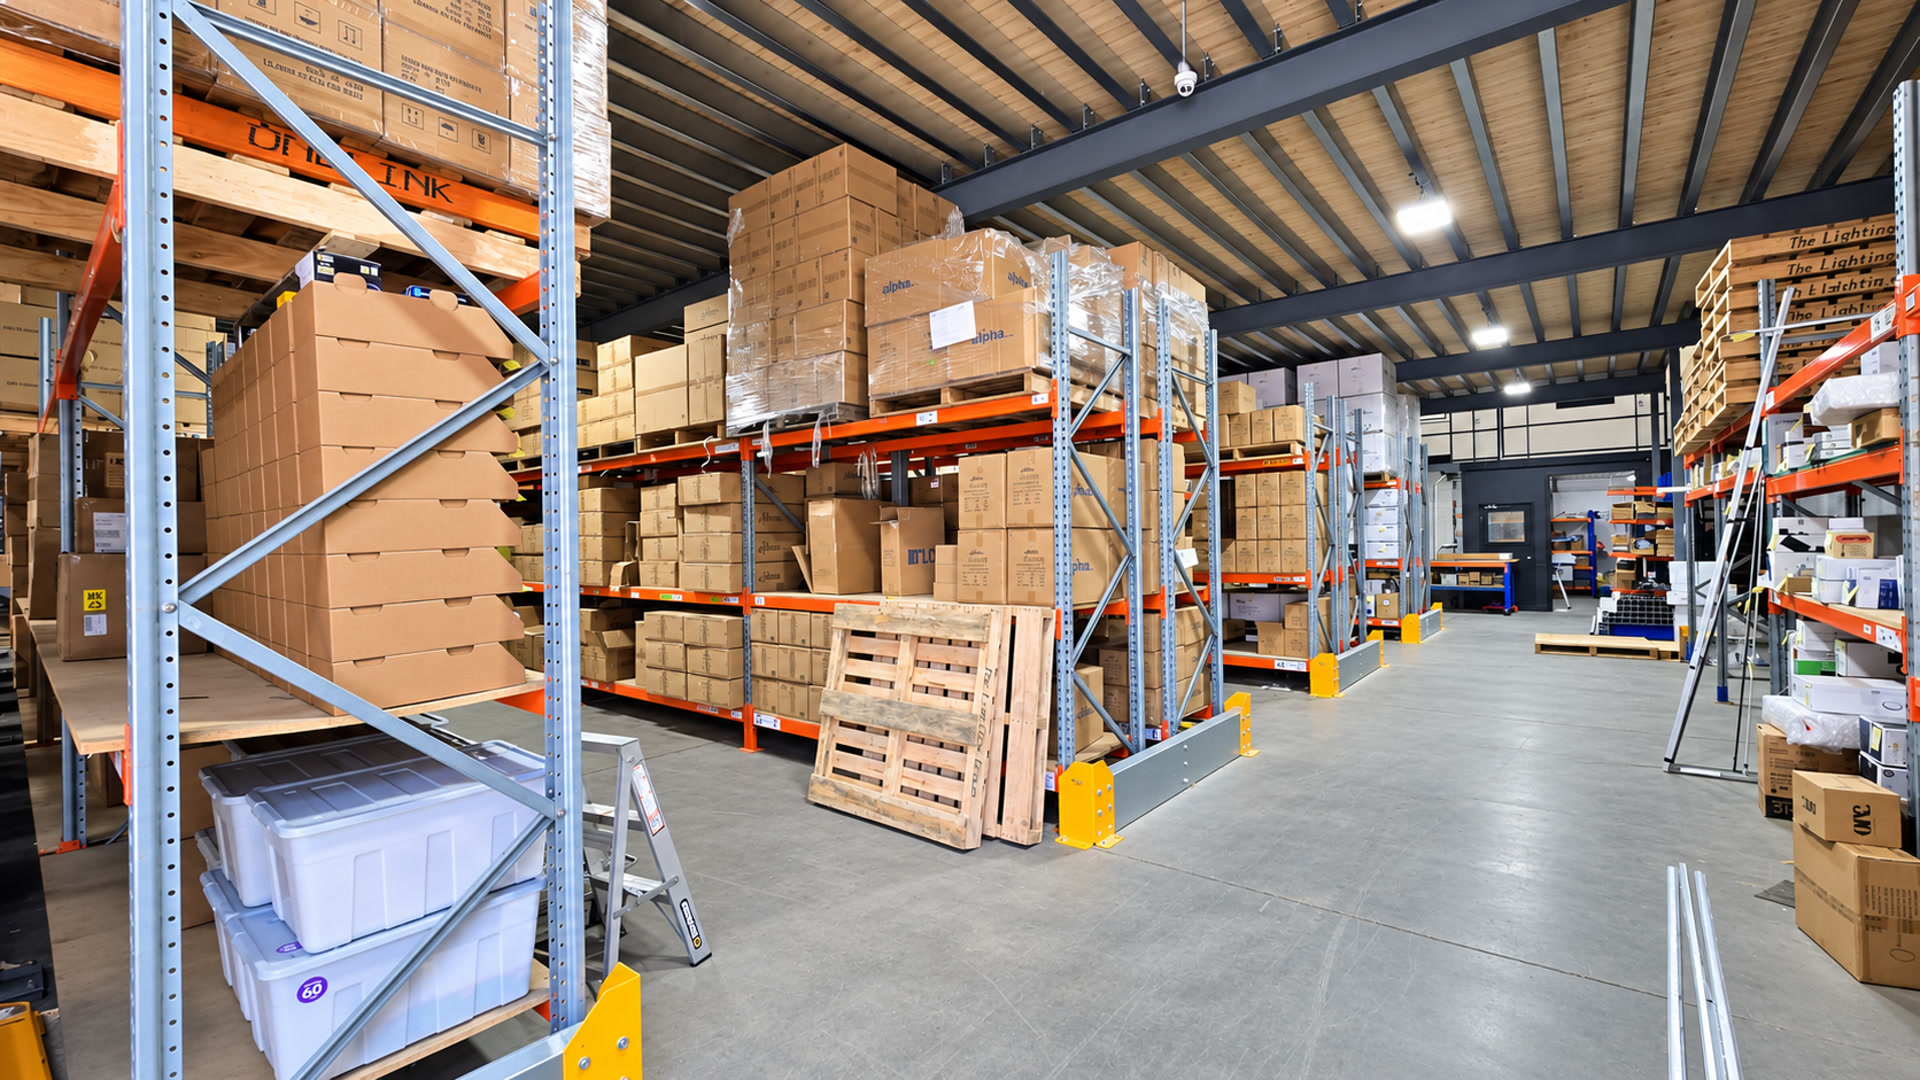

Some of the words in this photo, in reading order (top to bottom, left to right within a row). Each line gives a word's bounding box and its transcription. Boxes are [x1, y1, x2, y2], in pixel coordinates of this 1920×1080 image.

[1790, 236, 1816, 249] The
[1788, 263, 1813, 275] The
[301, 983, 322, 999] 60
